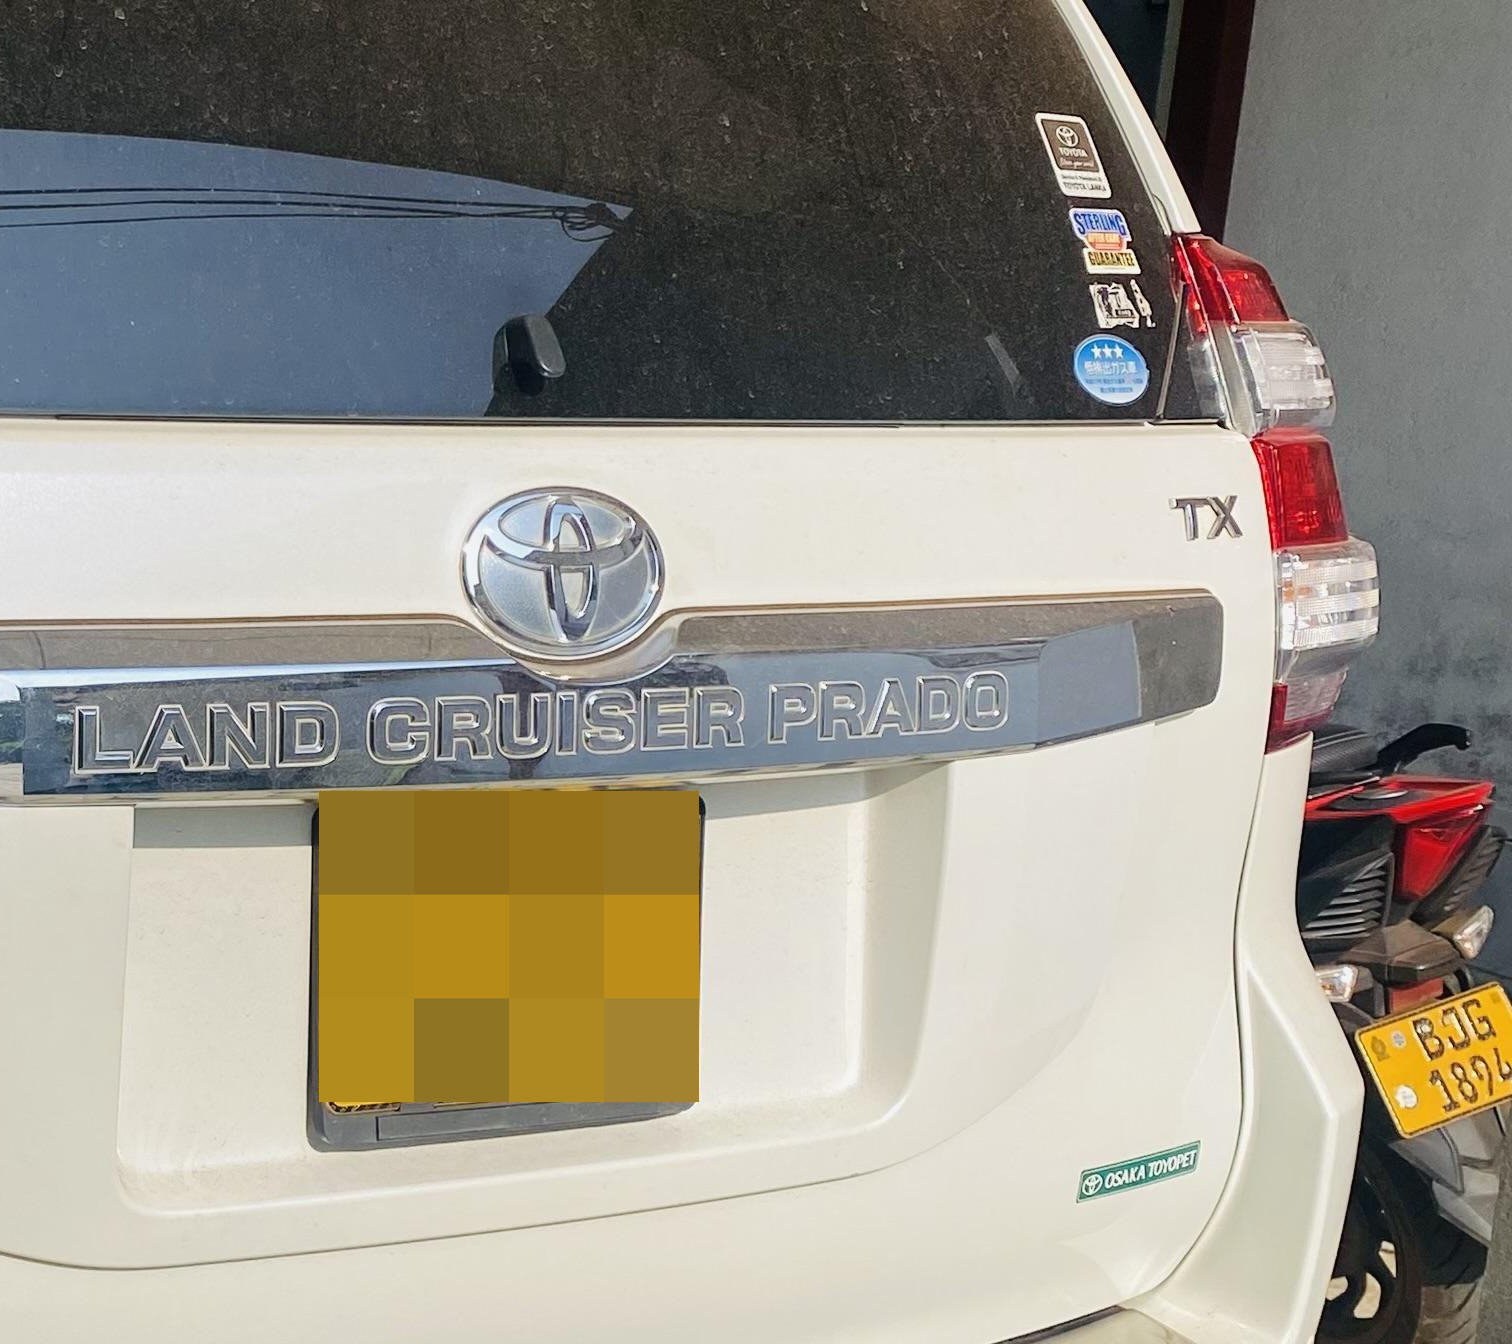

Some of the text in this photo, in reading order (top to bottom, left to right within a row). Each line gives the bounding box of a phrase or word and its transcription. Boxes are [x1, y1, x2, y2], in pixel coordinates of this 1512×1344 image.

[1059, 147, 1088, 157] TOYOTA
[1073, 213, 1127, 236] STERLING
[1088, 251, 1135, 267] GUARANTEE
[1168, 494, 1244, 542] TX
[73, 670, 1009, 775] LAND CRUISER PRADO
[1412, 998, 1497, 1062] BJG
[1104, 1149, 1198, 1189] OSAKA TOYOPET
